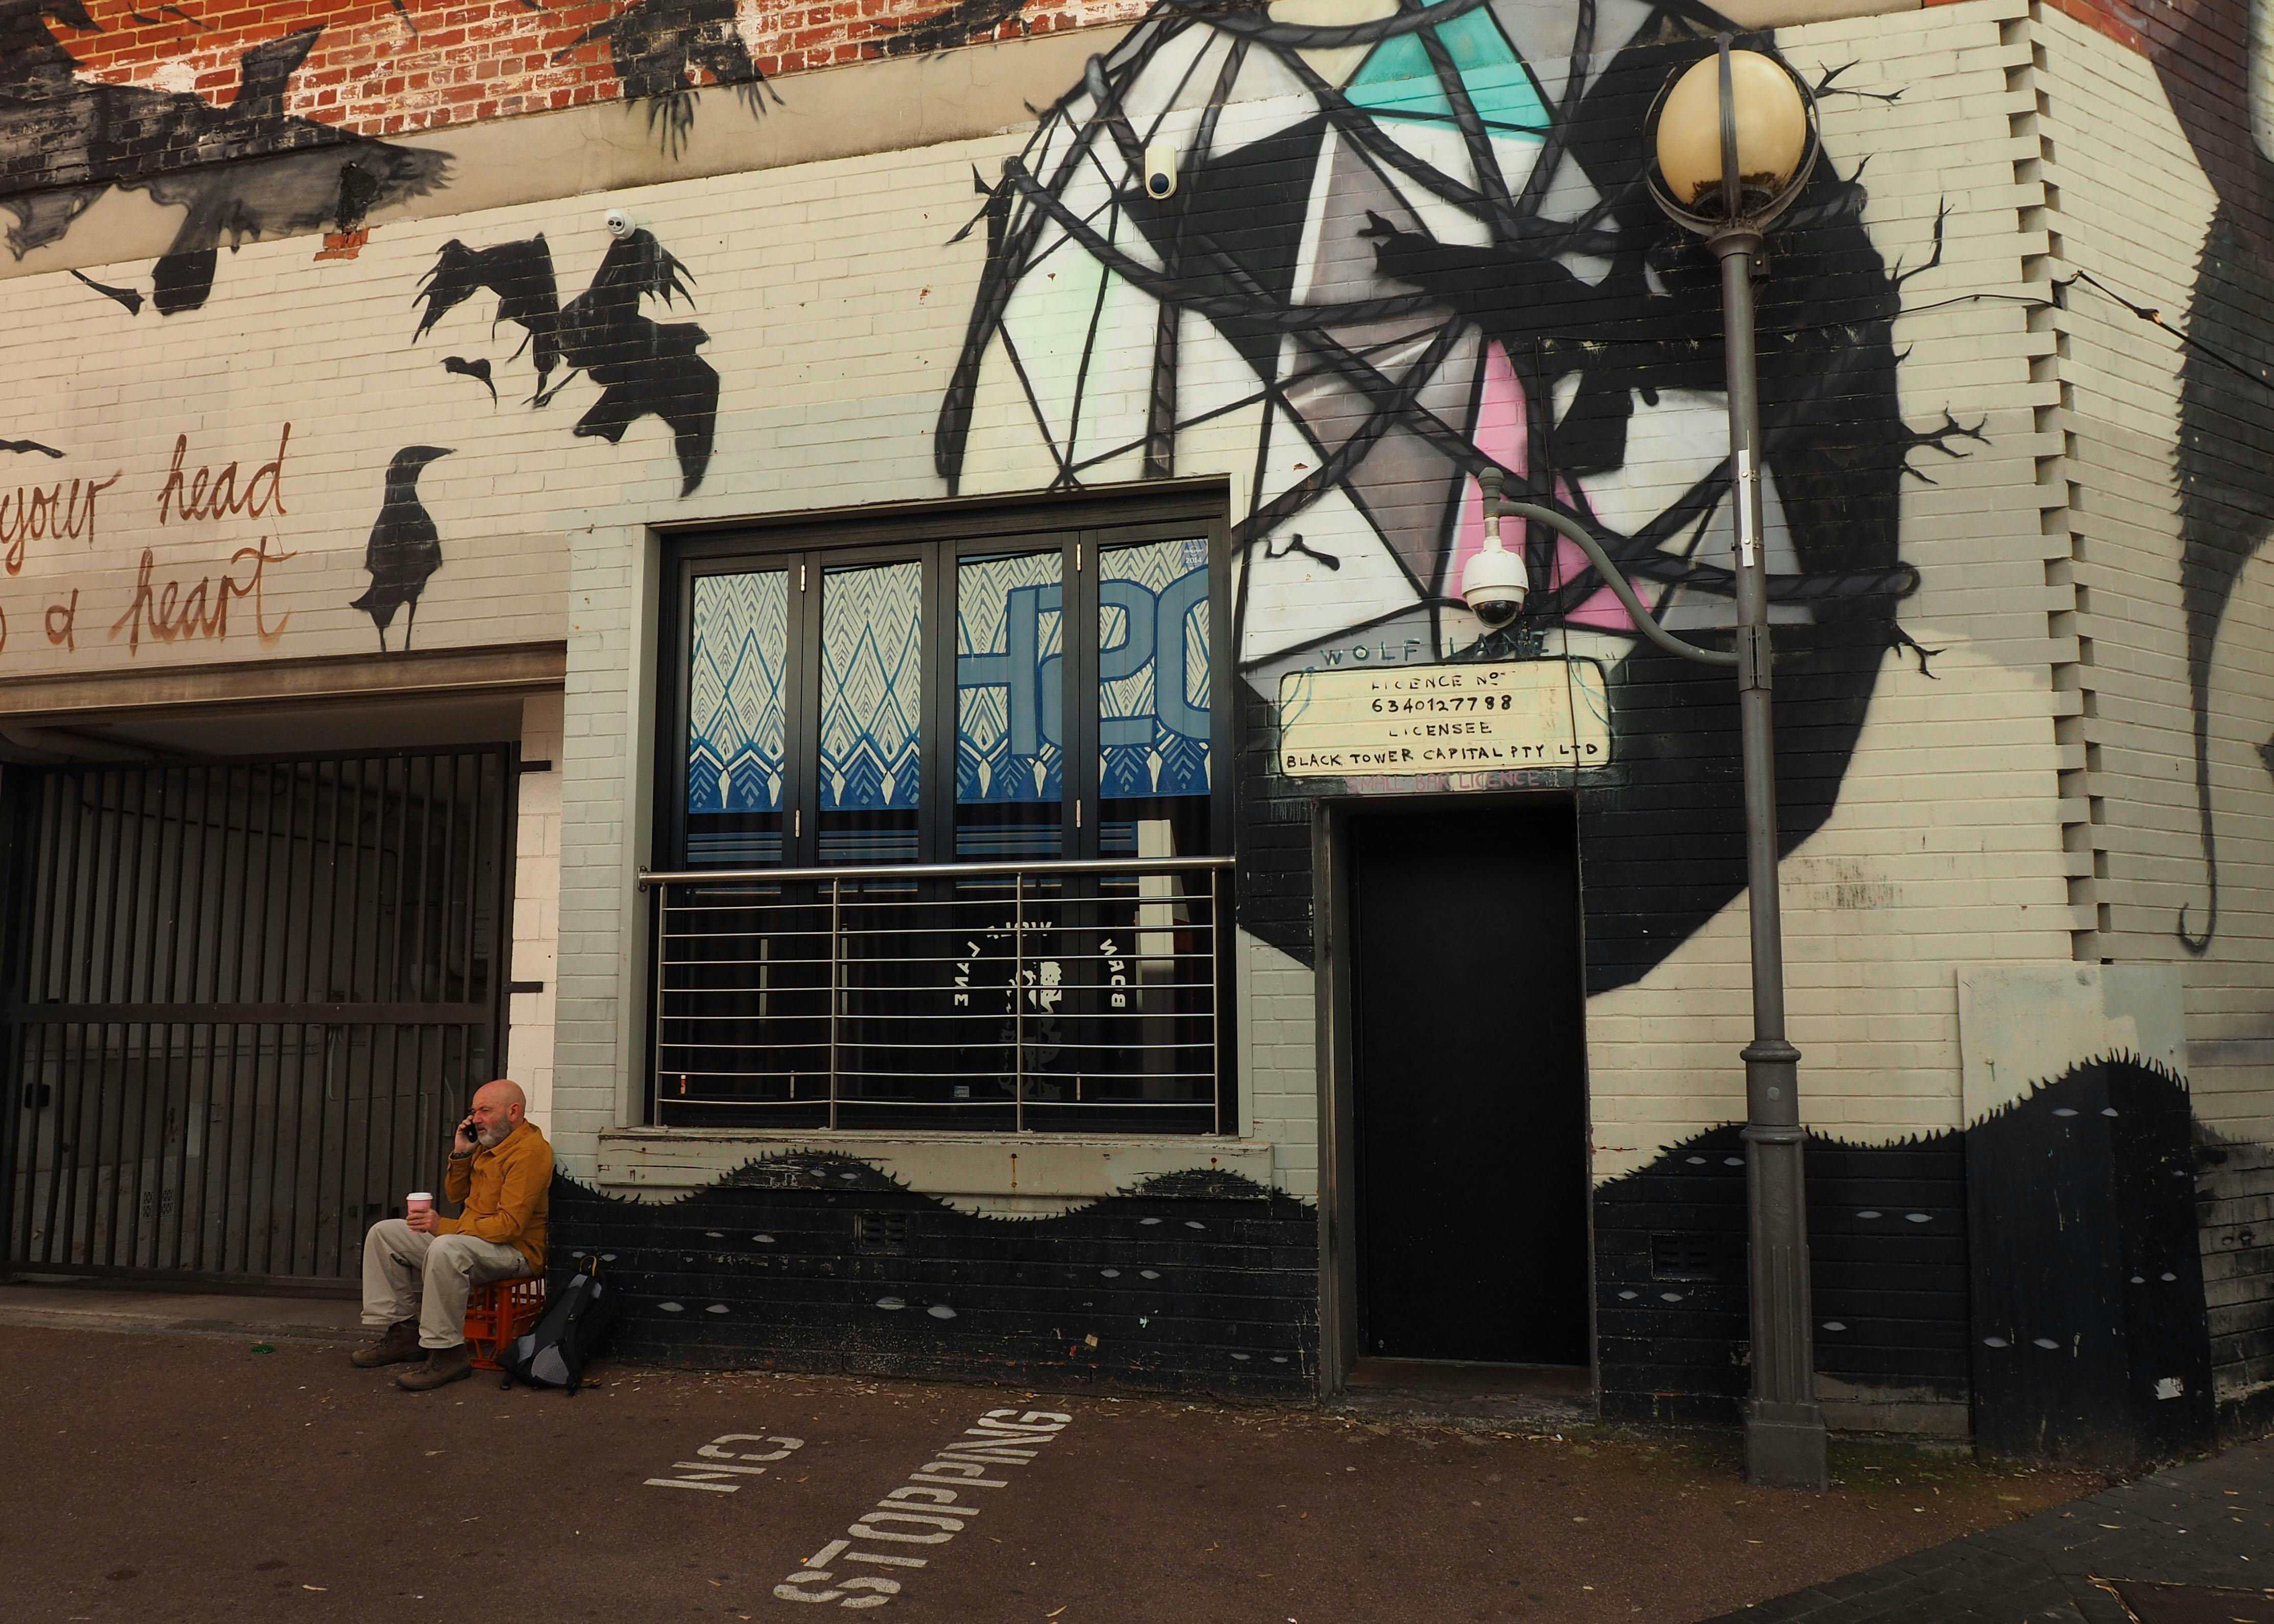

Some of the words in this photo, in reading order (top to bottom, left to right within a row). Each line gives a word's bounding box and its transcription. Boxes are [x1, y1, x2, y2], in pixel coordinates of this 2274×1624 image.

[0, 469, 123, 576] your
[157, 422, 291, 526] head
[45, 588, 78, 653] a
[107, 536, 298, 658] heart
[1320, 638, 1420, 666] WOLF
[1450, 631, 1550, 658] LANE
[1372, 675, 1462, 691] LICENCE
[1372, 695, 1512, 713] 6340127788
[1389, 721, 1492, 736] LICENSEE
[1286, 753, 1342, 768] BLACK
[1350, 748, 1413, 765] TOWER
[1423, 746, 1503, 760] CAPITAL
[1511, 744, 1545, 758] PTY
[1559, 743, 1598, 758] LTD
[1346, 774, 1405, 793] SMALL
[1415, 771, 1451, 792] BAR
[1458, 770, 1540, 790] LICENCE
[643, 1433, 805, 1493] NO
[773, 1409, 1073, 1609] STOPPING
